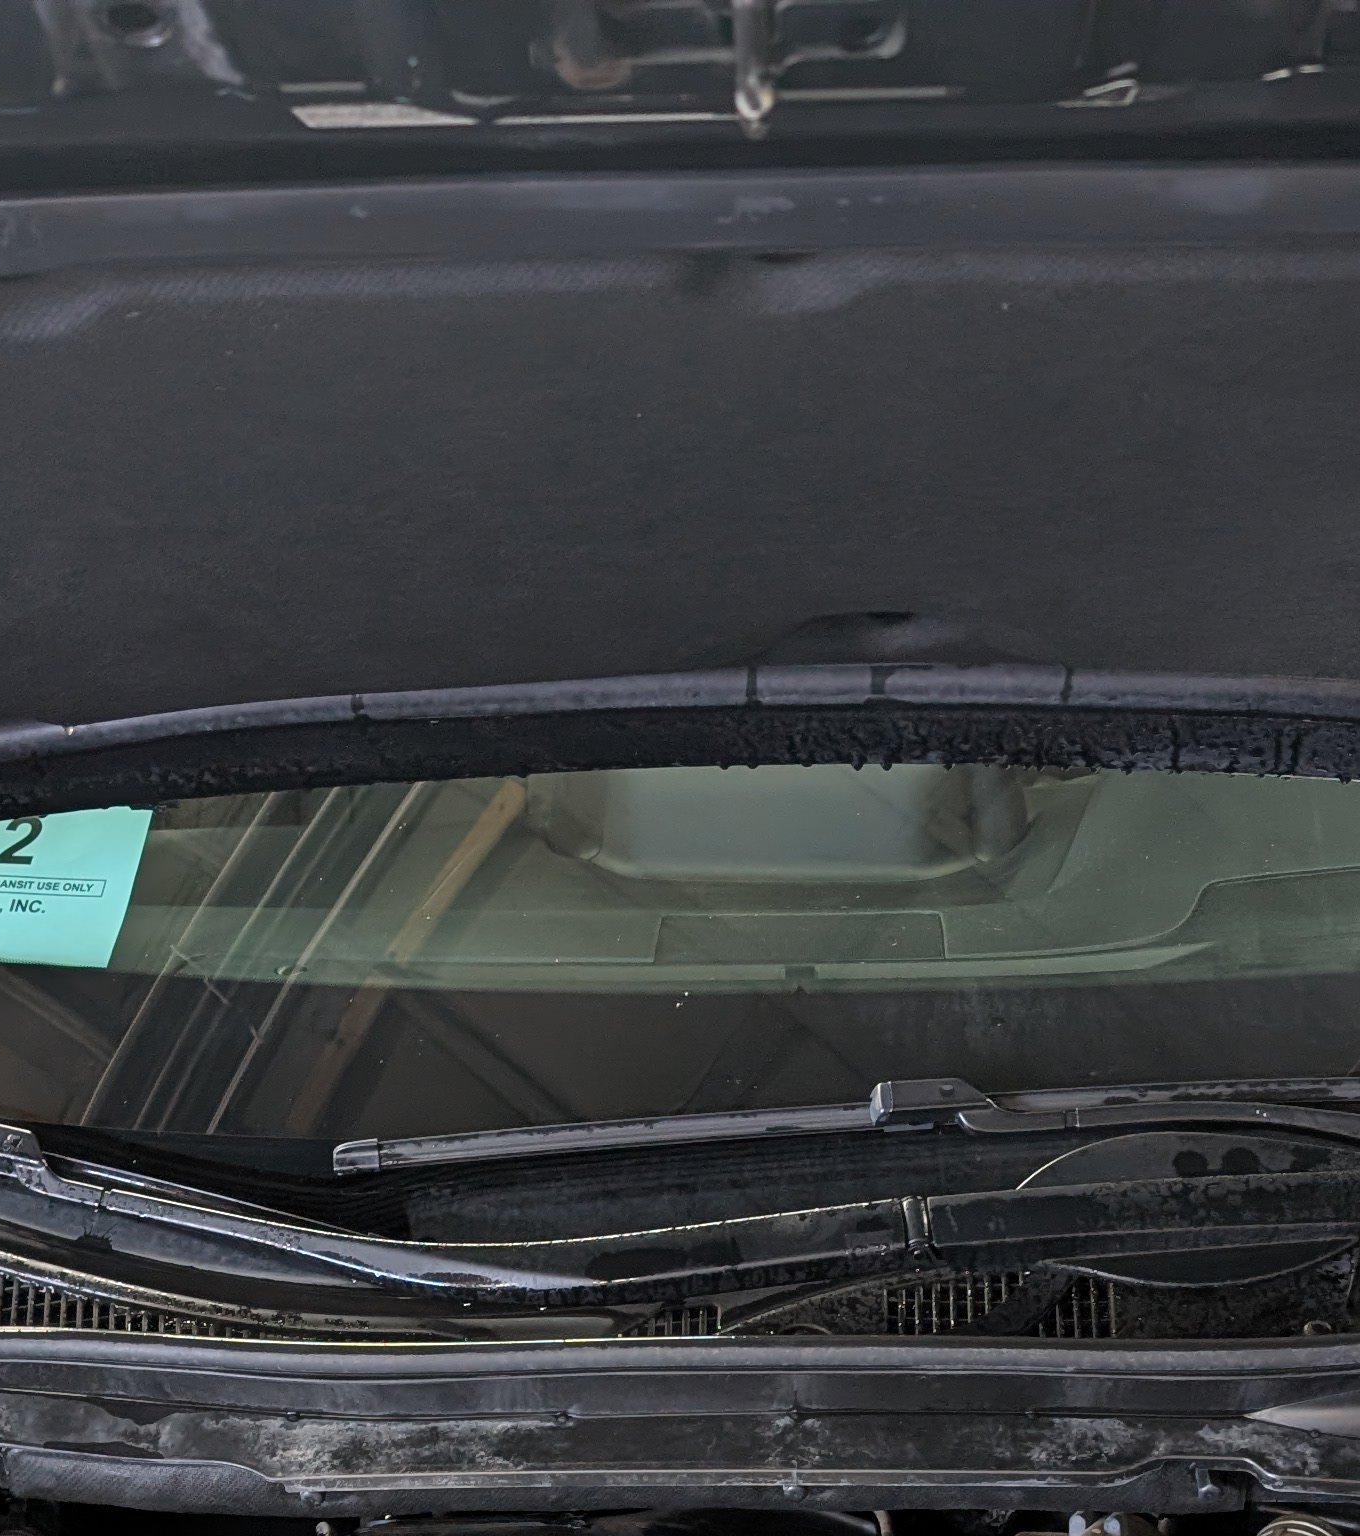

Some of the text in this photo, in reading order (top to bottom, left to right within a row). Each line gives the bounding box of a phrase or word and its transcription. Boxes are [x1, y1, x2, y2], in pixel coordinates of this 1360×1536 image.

[36, 881, 60, 891] USE
[62, 882, 95, 893] ONLY
[9, 898, 46, 914] INC.
